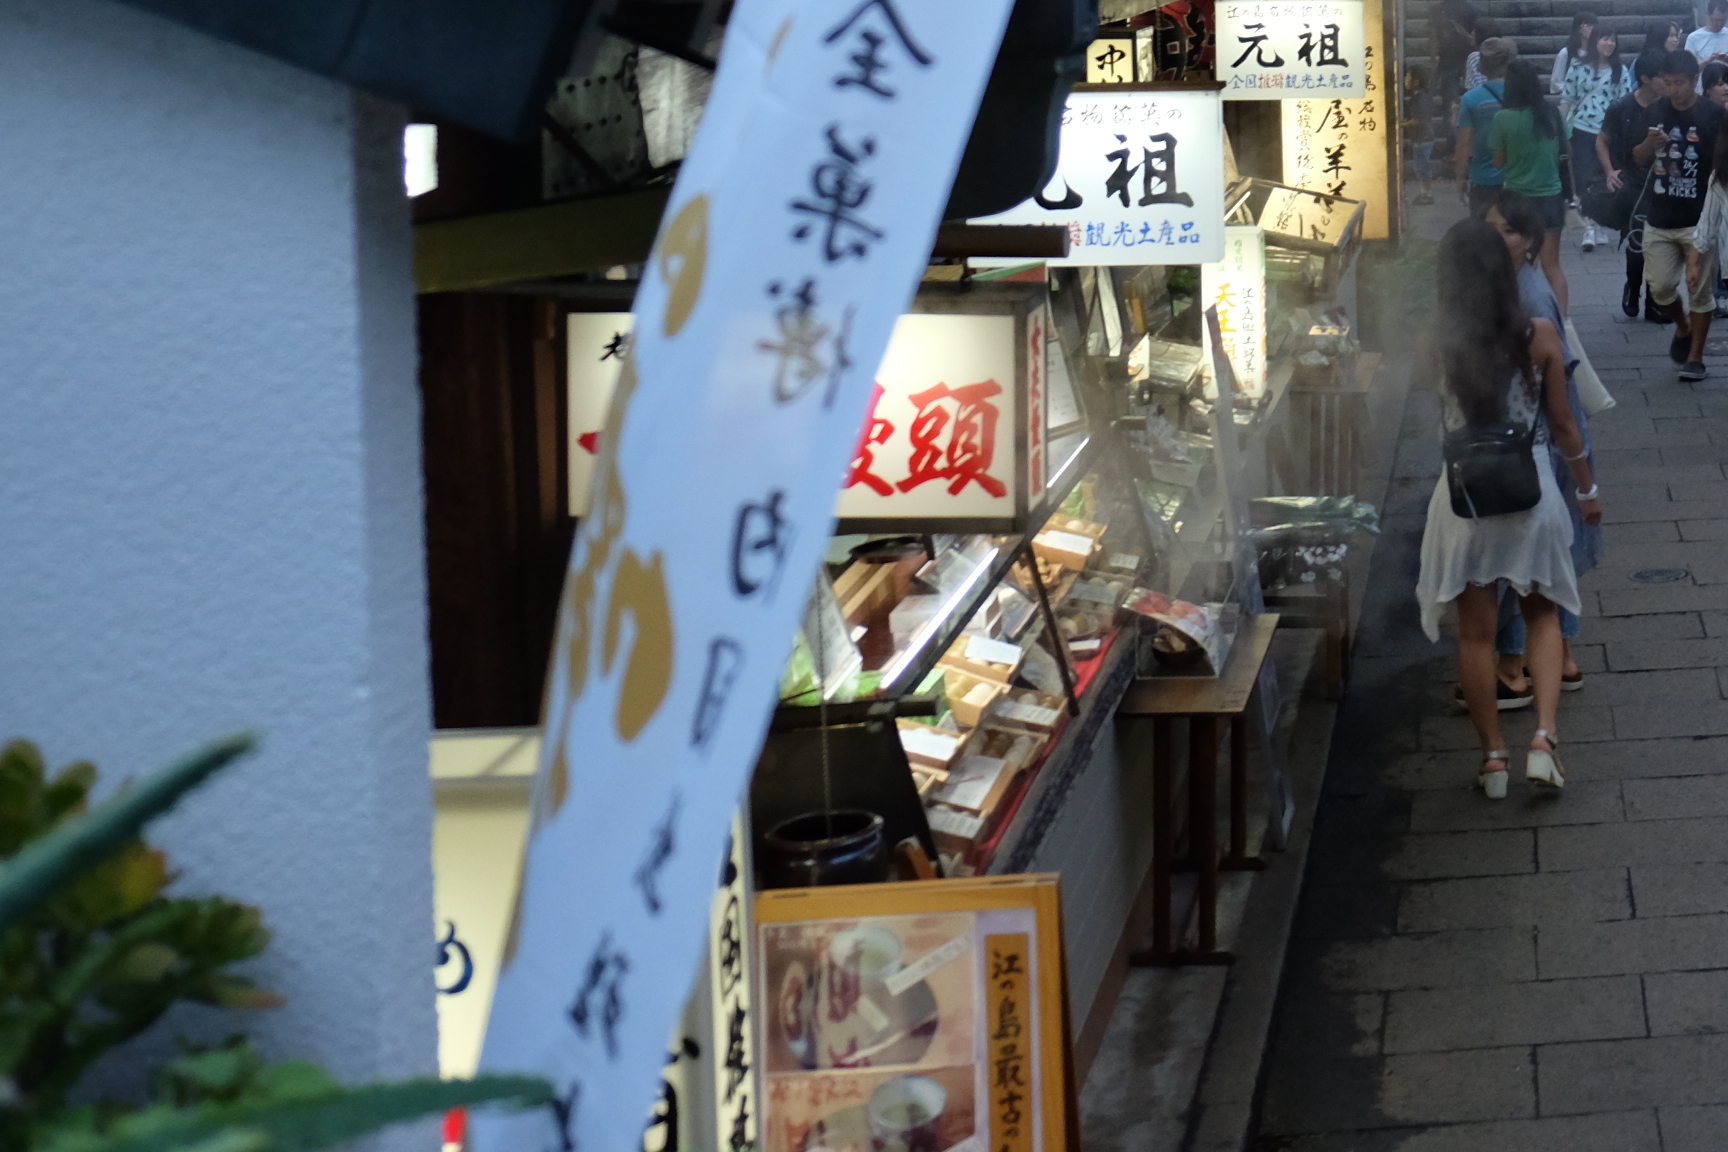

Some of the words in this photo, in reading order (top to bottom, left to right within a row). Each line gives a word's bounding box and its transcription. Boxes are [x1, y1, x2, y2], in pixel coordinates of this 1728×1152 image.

[1095, 44, 1127, 83] 中
[1231, 23, 1349, 68] 元祖
[1668, 185, 1697, 198] KICKS
